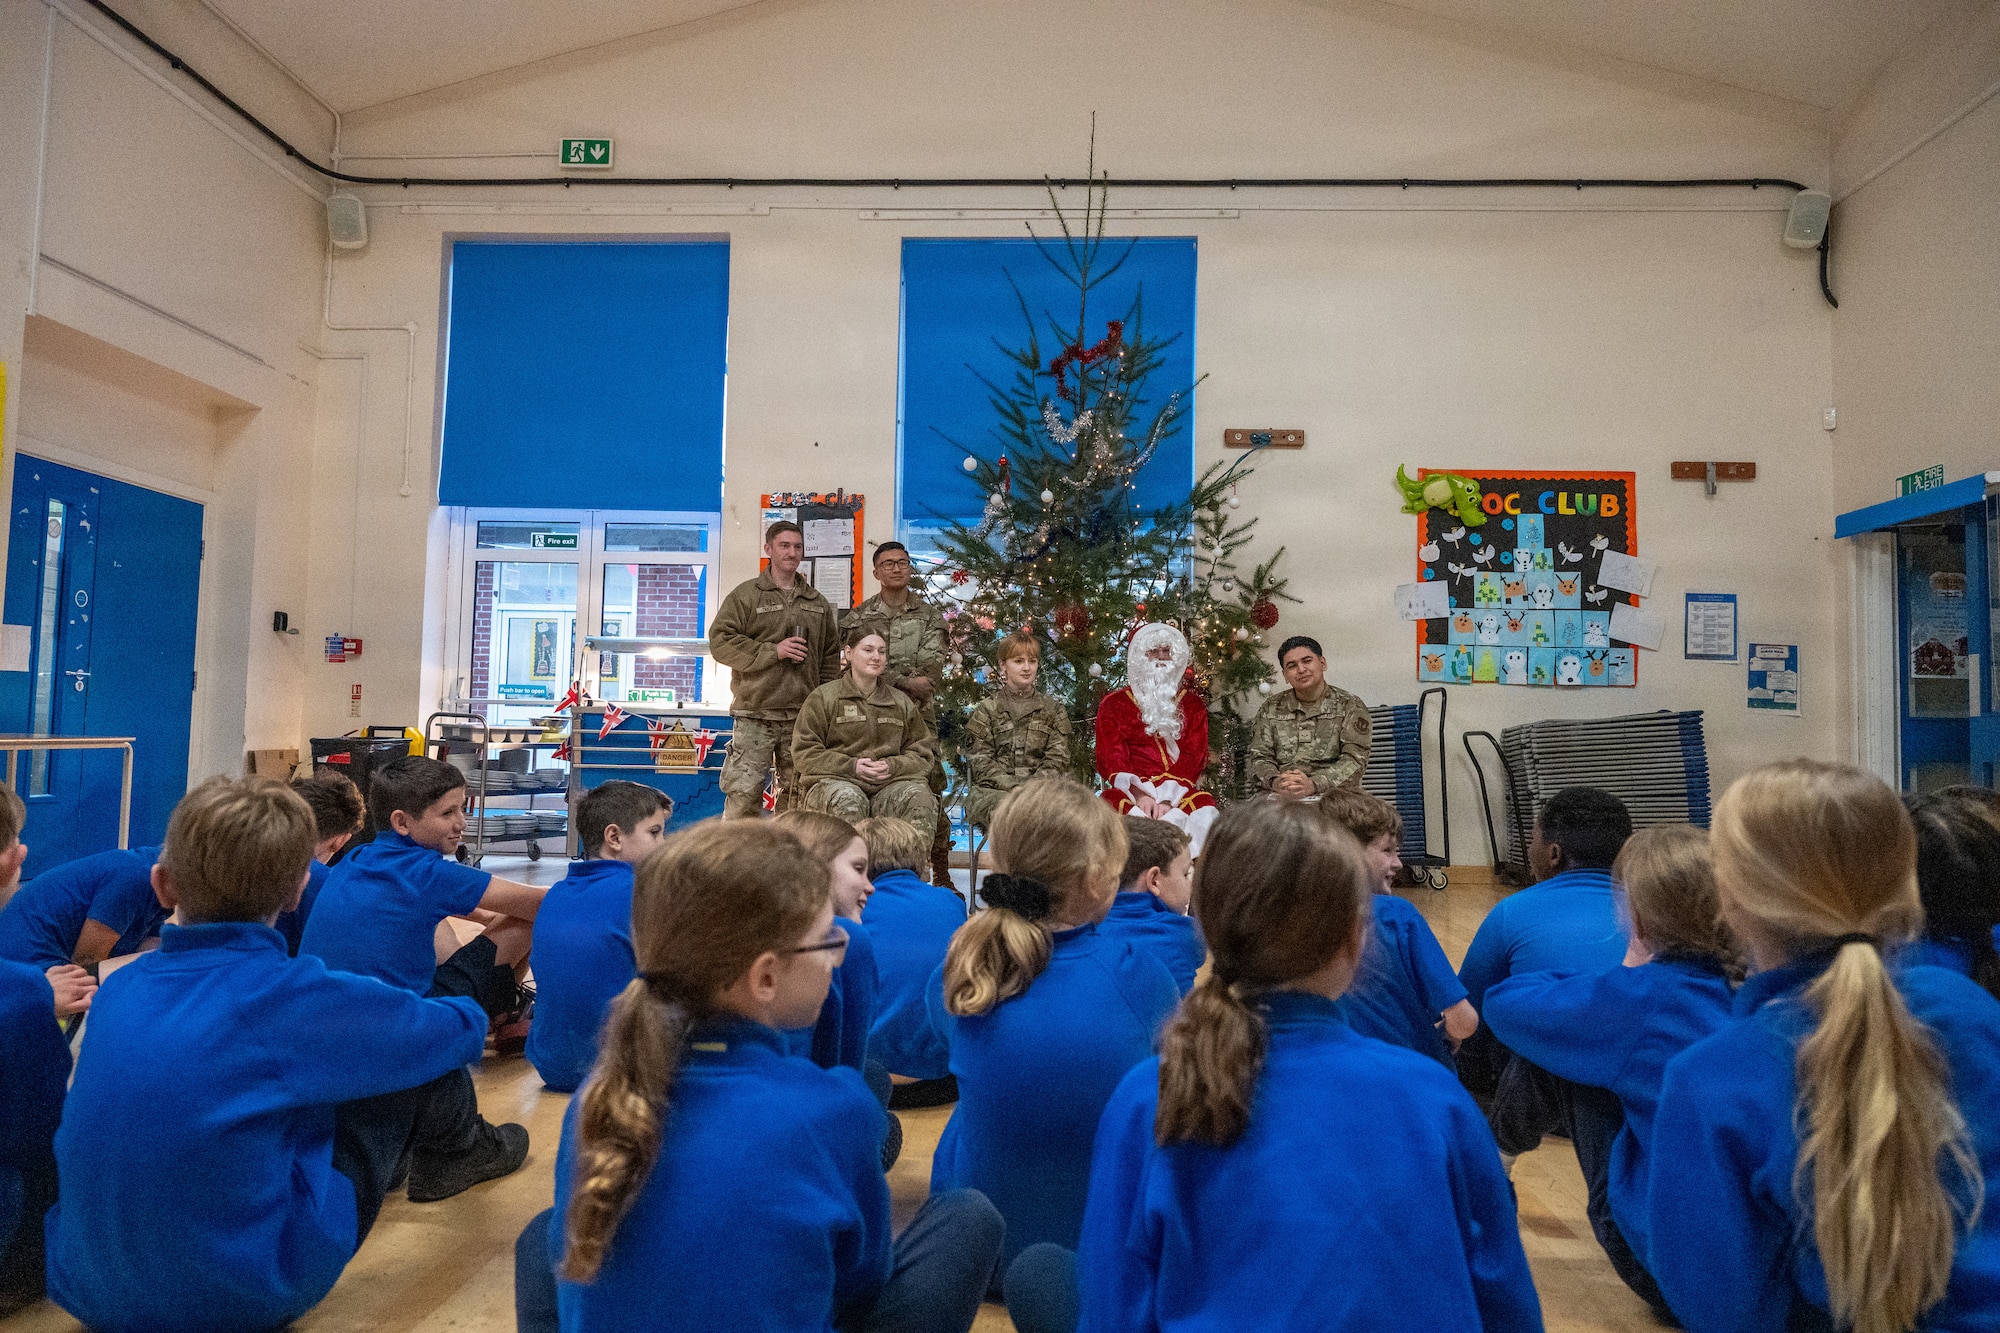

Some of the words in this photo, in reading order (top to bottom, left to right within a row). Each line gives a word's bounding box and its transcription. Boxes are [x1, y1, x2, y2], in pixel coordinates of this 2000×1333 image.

[1924, 465, 1943, 480] FIRE
[1924, 477, 1943, 491] EXIT
[1537, 491, 1620, 517] CLUB
[547, 537, 561, 545] Fire
